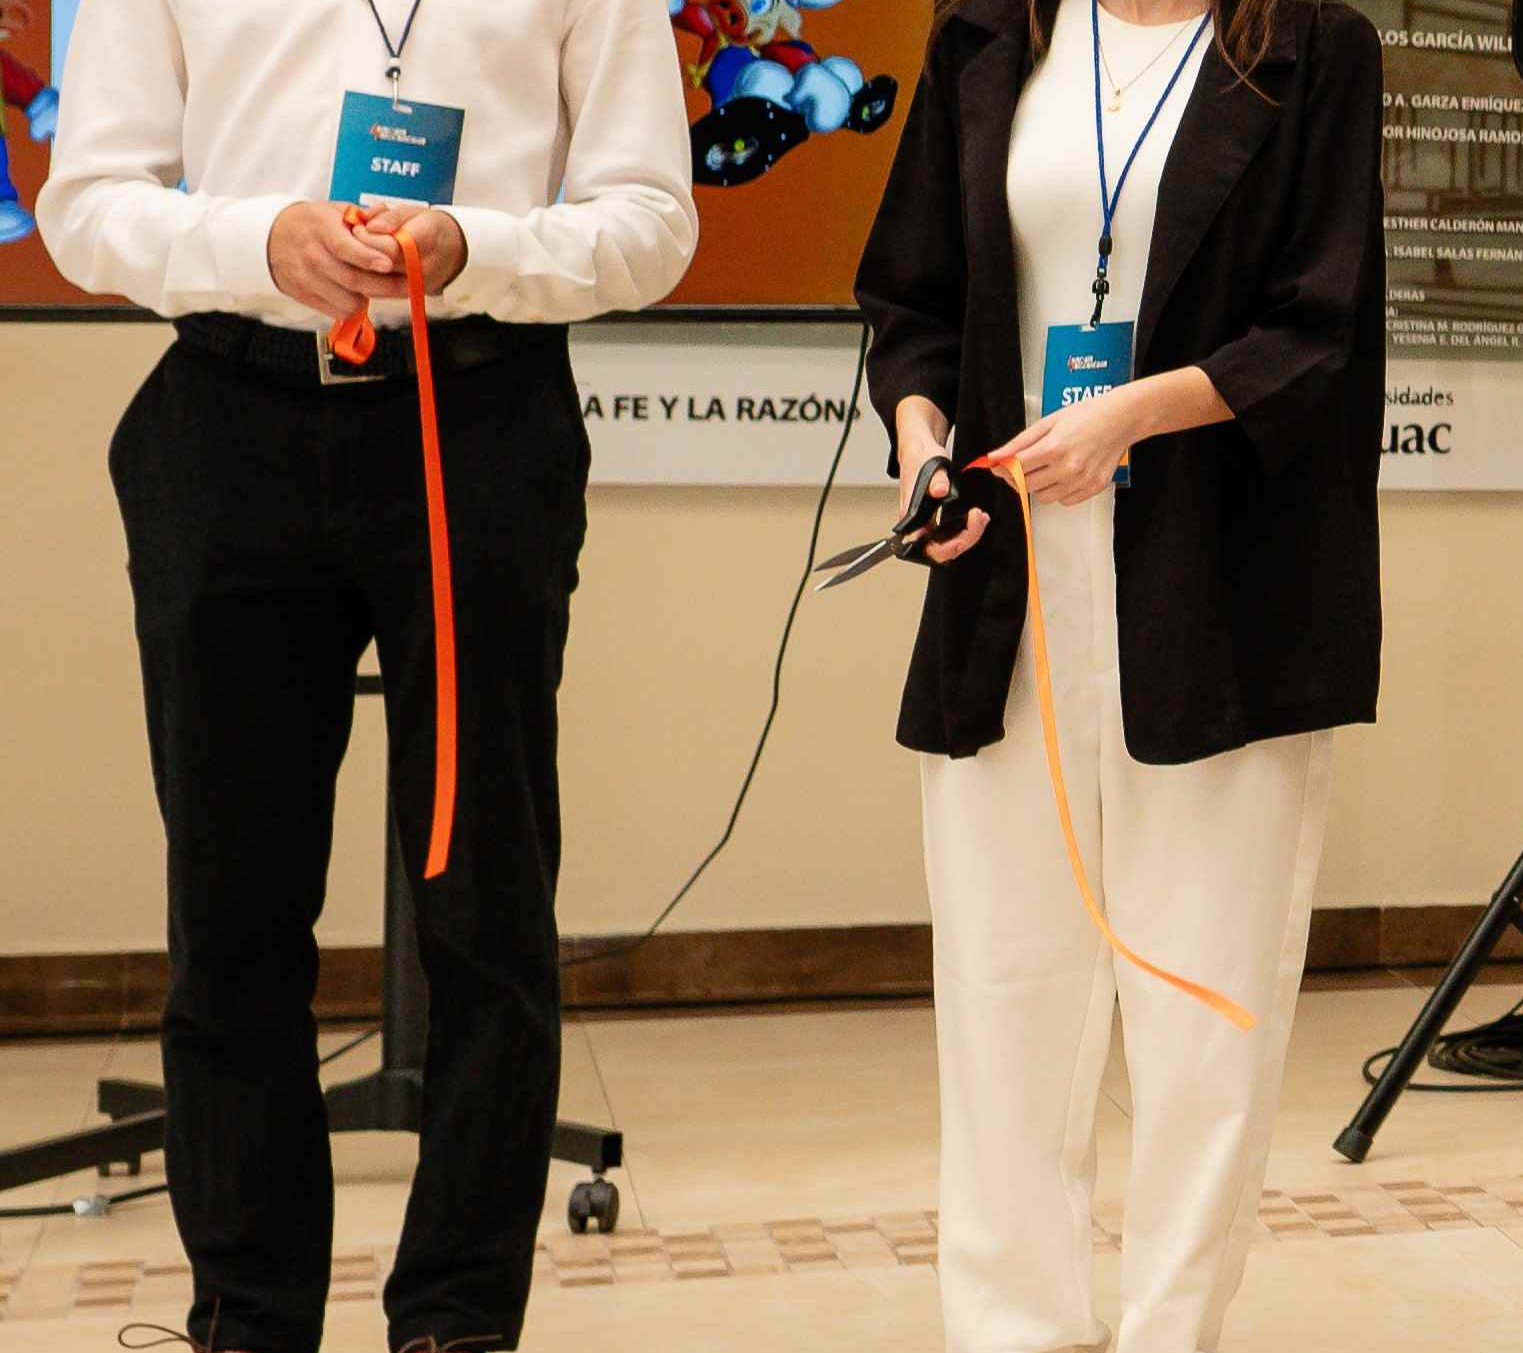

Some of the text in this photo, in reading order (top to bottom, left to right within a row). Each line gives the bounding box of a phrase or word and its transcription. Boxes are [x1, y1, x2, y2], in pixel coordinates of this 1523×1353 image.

[1411, 28, 1474, 50] GARCÍA
[1411, 94, 1458, 110] GARZA
[1406, 126, 1477, 143] HINOJOSA
[370, 156, 421, 177] STAFF
[1430, 216, 1494, 233] CALDERÓN
[613, 397, 649, 419] FE
[660, 397, 678, 420] Y
[687, 398, 726, 420] LA
